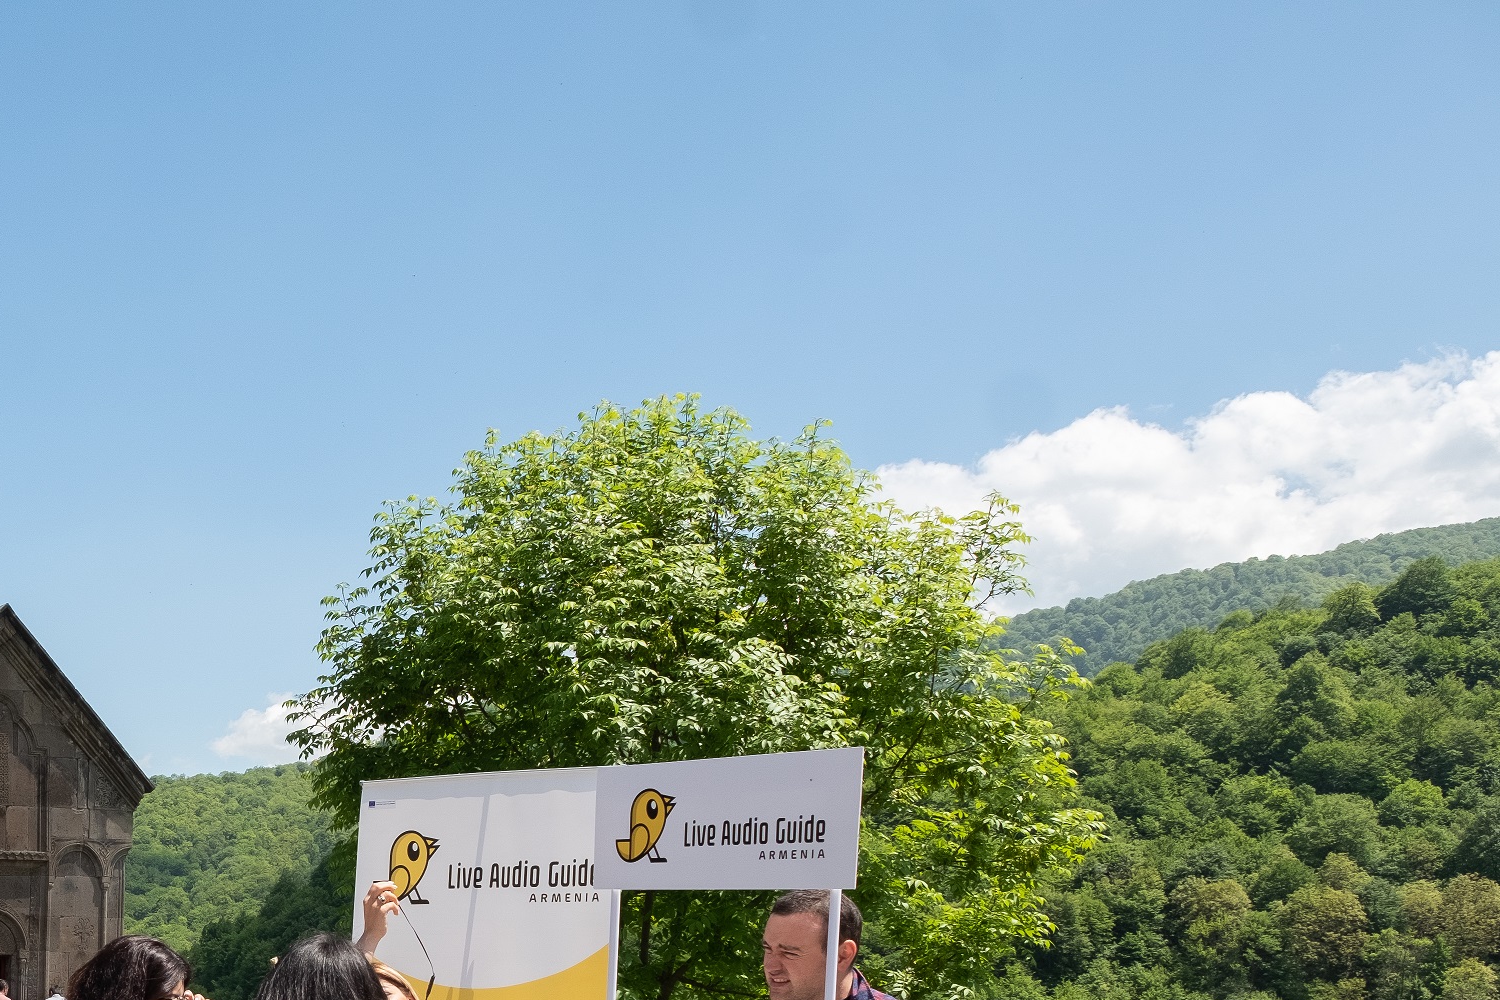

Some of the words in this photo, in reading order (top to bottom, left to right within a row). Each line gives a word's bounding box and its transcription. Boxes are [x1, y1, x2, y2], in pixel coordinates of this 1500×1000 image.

[684, 820, 716, 847] Live
[721, 817, 769, 846] Audio
[776, 814, 826, 844] Guide
[758, 849, 825, 860] ARMENIA
[448, 862, 483, 889] Live
[489, 860, 540, 888] Audio
[529, 892, 600, 903] ARMENIA
